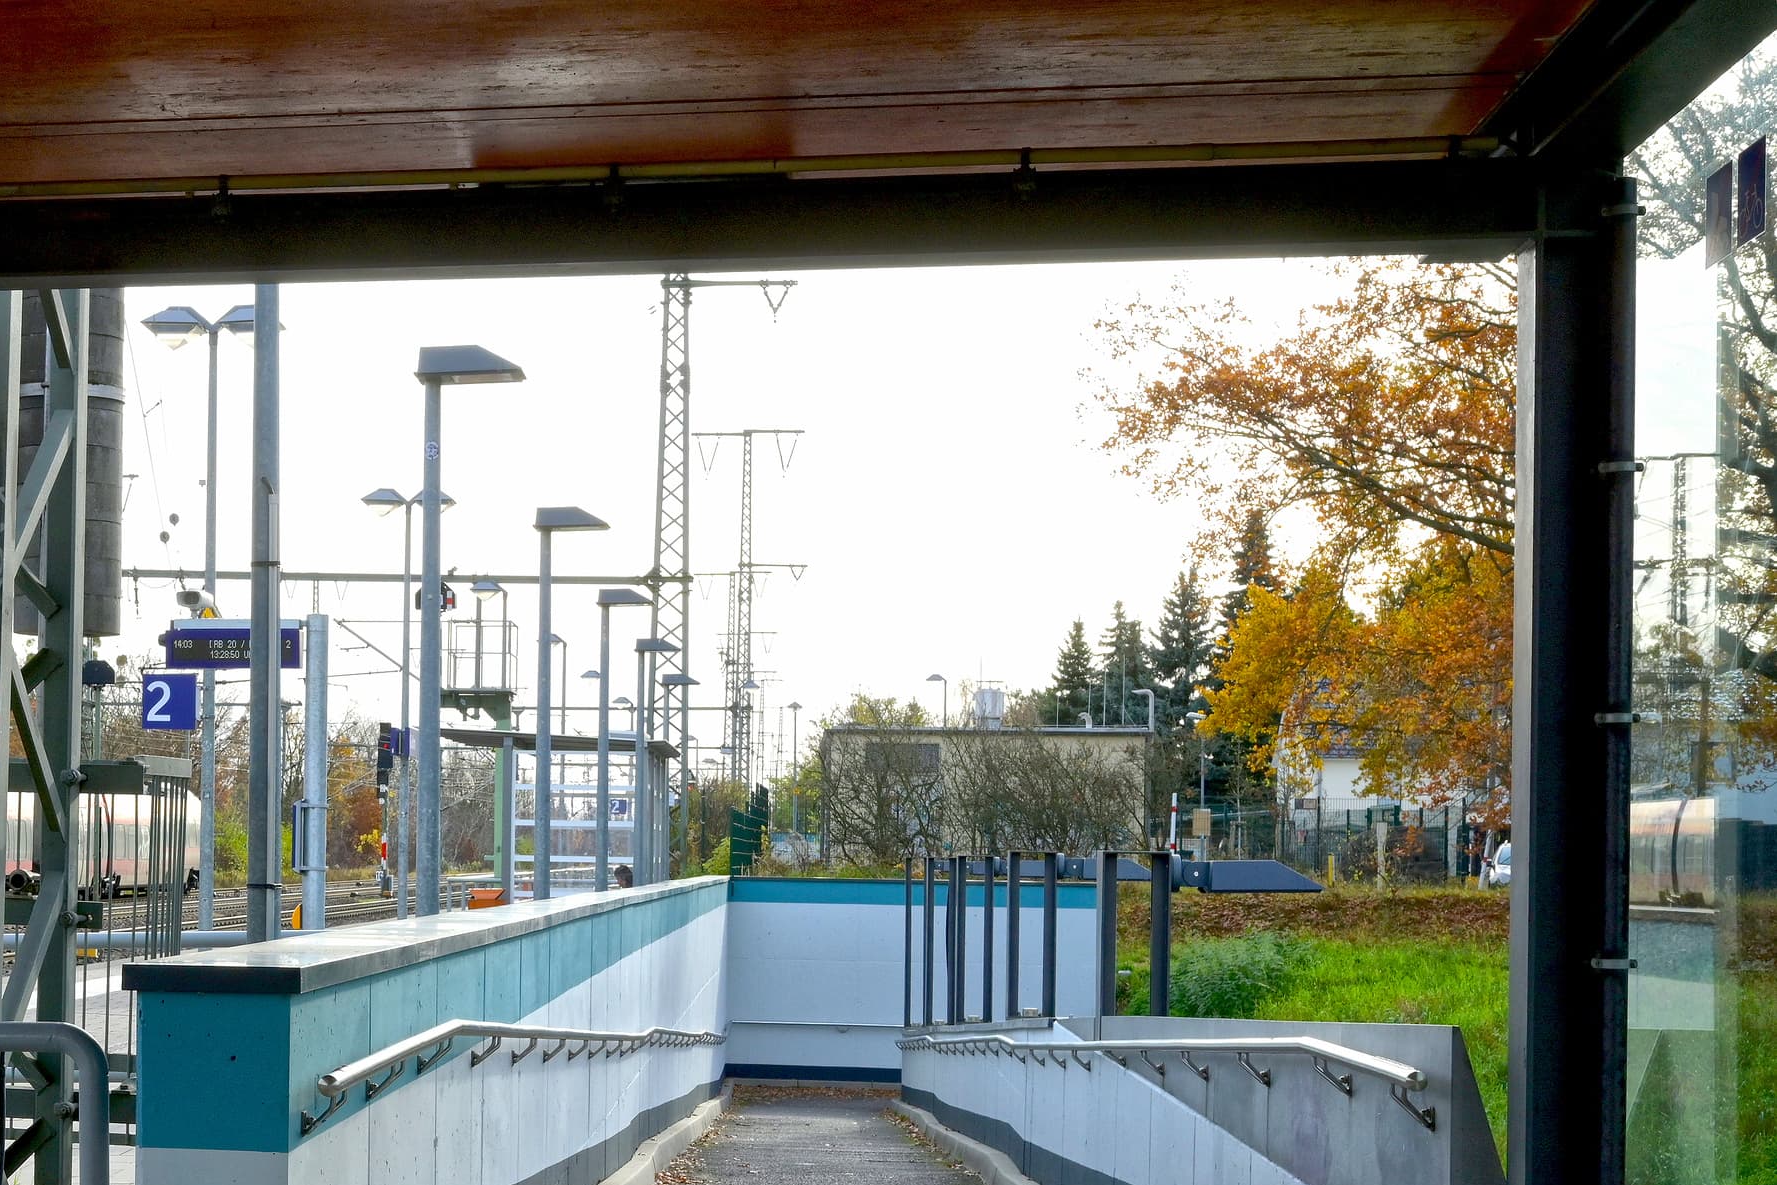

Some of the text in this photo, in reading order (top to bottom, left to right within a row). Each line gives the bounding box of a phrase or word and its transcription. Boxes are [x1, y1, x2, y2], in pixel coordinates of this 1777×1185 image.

[174, 640, 192, 649] 14:03
[227, 640, 237, 649] 20
[285, 640, 291, 648] 2
[210, 650, 239, 659] 13:28:50
[146, 680, 171, 722] 2
[611, 800, 620, 813] 2
